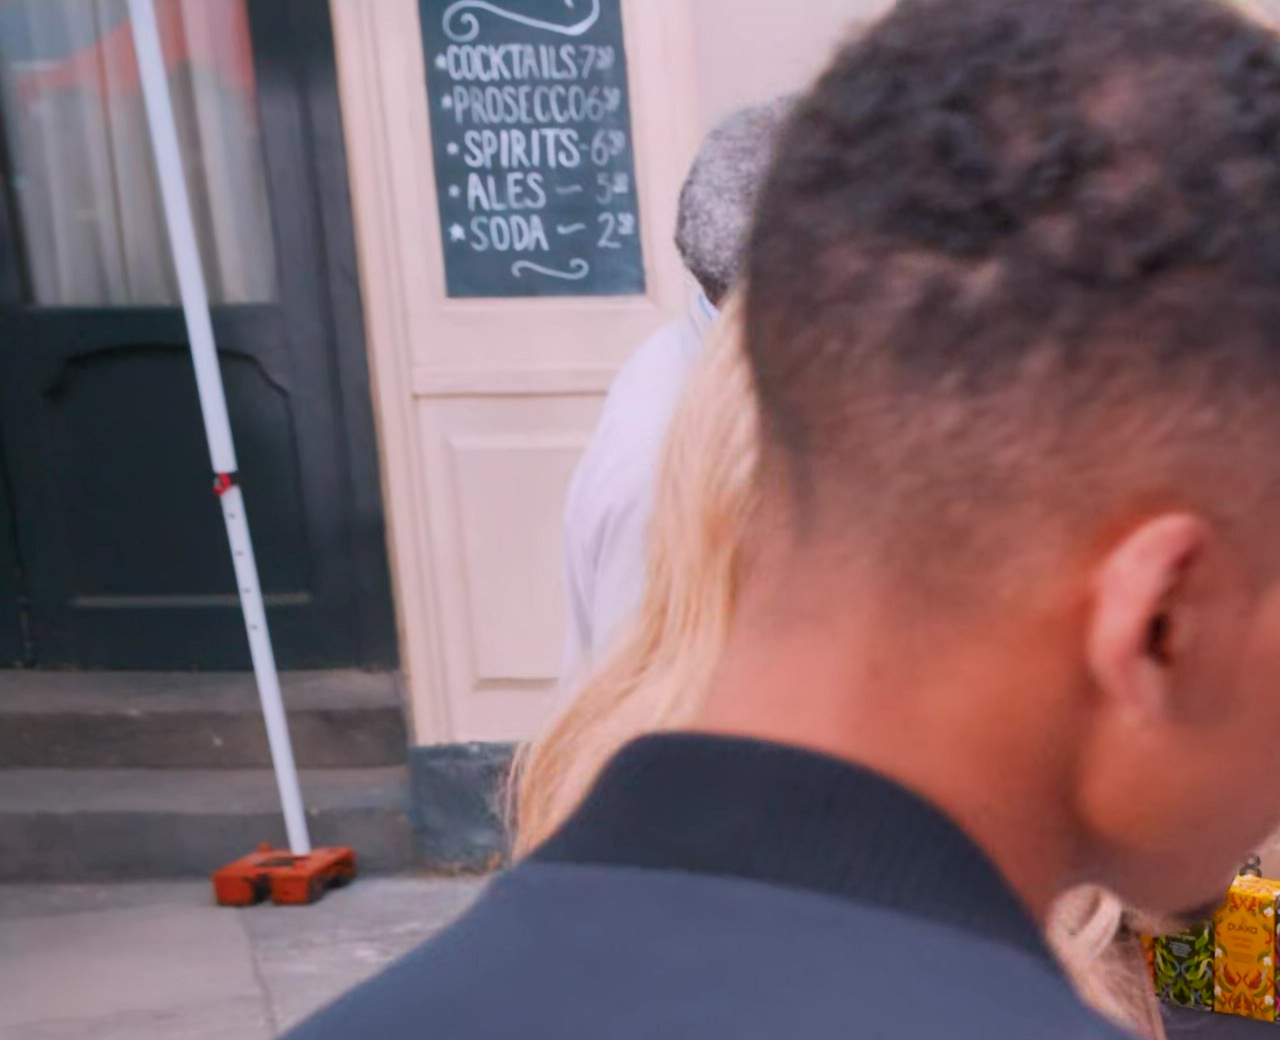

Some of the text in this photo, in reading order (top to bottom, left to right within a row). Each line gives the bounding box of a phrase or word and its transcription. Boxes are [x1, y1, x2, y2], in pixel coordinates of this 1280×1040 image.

[446, 43, 579, 81] COCKTAILS
[453, 85, 586, 124] PROSECCO
[463, 127, 581, 168] SPIRITS
[467, 171, 546, 211] ALES
[470, 213, 549, 251] SODA
